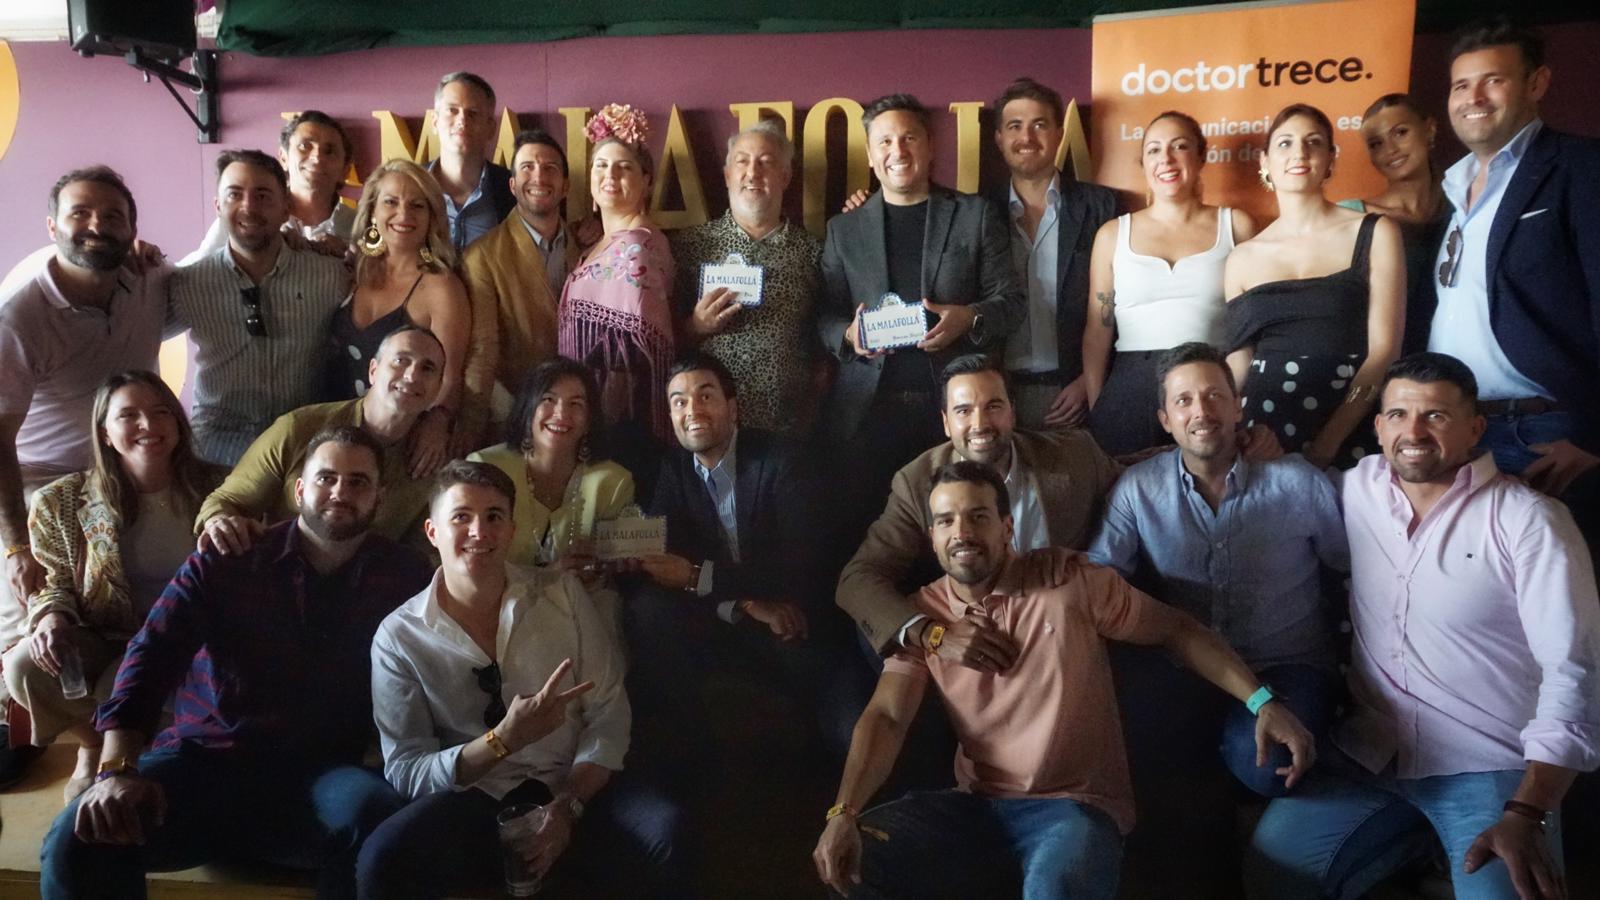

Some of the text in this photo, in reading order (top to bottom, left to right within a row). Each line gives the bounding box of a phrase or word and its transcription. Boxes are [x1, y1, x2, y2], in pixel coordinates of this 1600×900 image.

[1120, 124, 1145, 141] La
[1336, 115, 1363, 131] es
[706, 275, 715, 284] LA
[866, 322, 876, 332] LA
